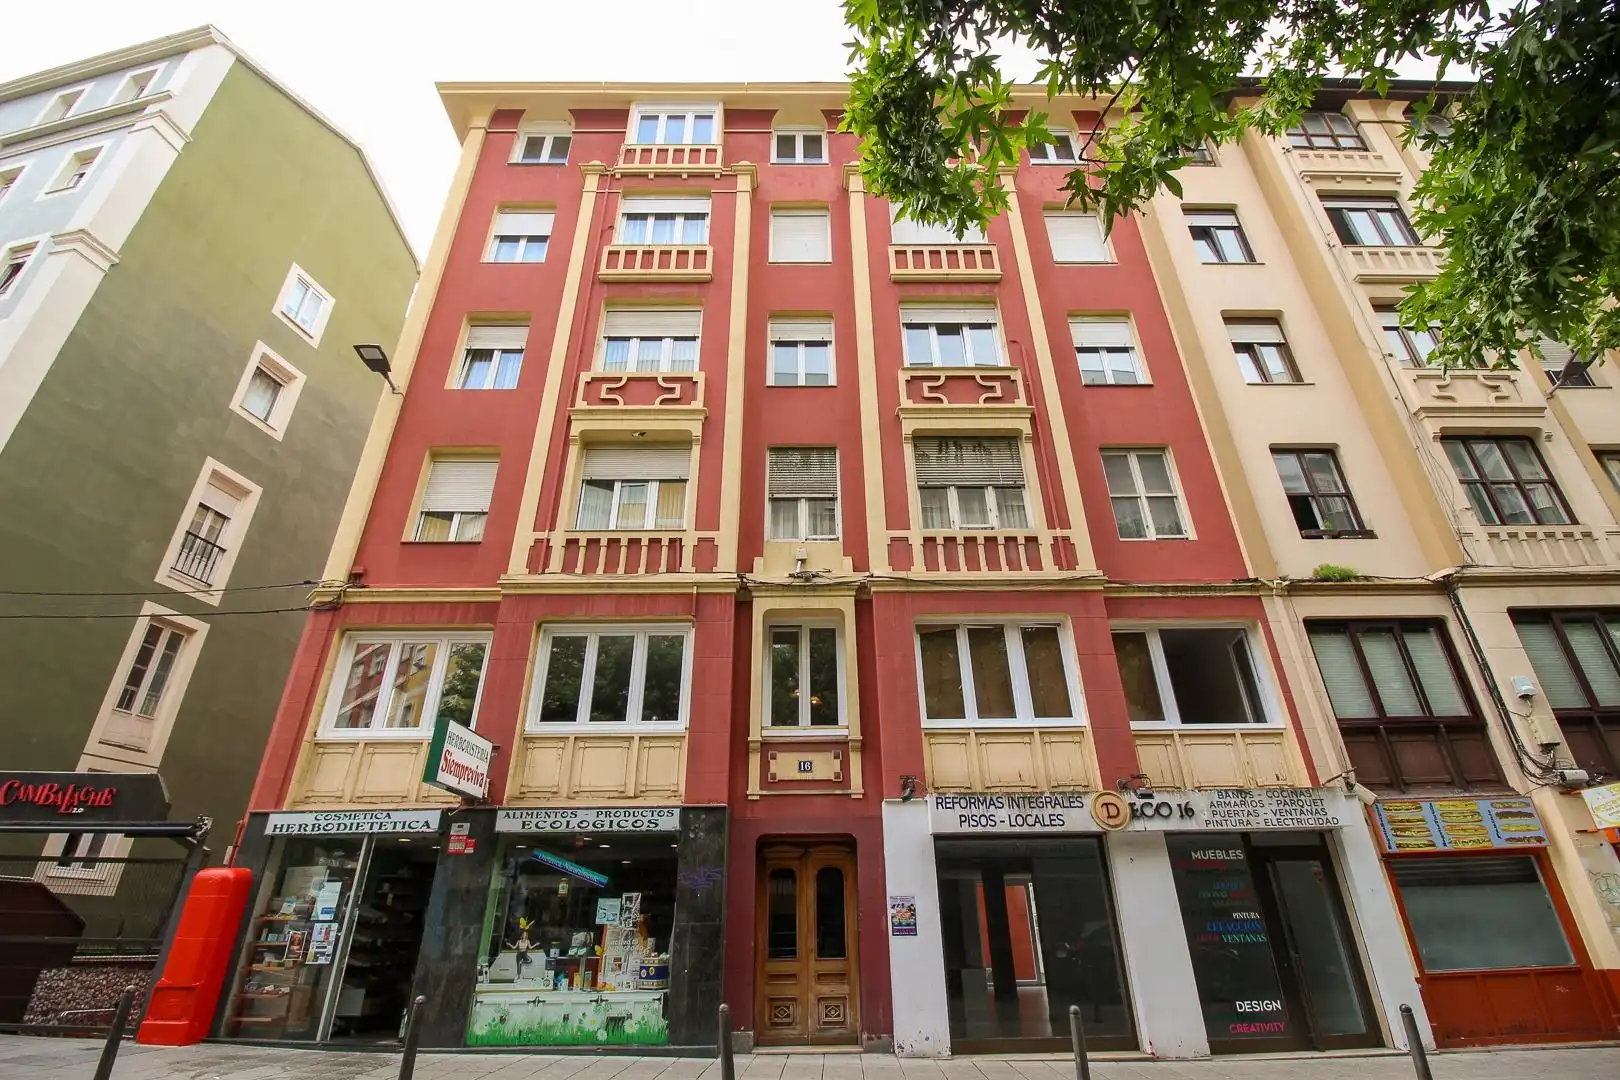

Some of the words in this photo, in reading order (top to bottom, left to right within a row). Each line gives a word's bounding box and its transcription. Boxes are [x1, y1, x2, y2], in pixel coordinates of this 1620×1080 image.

[447, 730, 489, 763] HERBORISTERIA
[441, 748, 485, 788] Siempreviva
[800, 761, 811, 771] 16
[0, 779, 119, 814] CAMBALACHE
[1266, 790, 1312, 798] COCINAS
[935, 796, 1004, 810] REFORMAS
[1008, 795, 1084, 809] INTEGRALES
[1210, 800, 1265, 808] ARMARIOS
[1276, 799, 1324, 808] PARQUET
[503, 811, 578, 819] ALIMENTOS
[596, 809, 674, 818] PRODUCTOS
[1177, 801, 1195, 818] 16
[1212, 809, 1259, 818] PUERTAS
[1271, 808, 1328, 817] VENTANAS
[315, 812, 392, 821] COSMETICA
[959, 813, 997, 828] PISOS
[1009, 813, 1065, 827] LOCALES
[1205, 819, 1252, 827] PINTURA
[1264, 817, 1339, 826] ELECTRICIDAD
[272, 820, 431, 833] HERBODIETETICA
[521, 819, 660, 830] ECOLOGICOS
[1191, 850, 1244, 860] MUEBLES
[1221, 934, 1267, 943] VENTANAS
[1235, 1000, 1282, 1012] DESIGN
[1229, 1022, 1285, 1034] CREATIVITY
